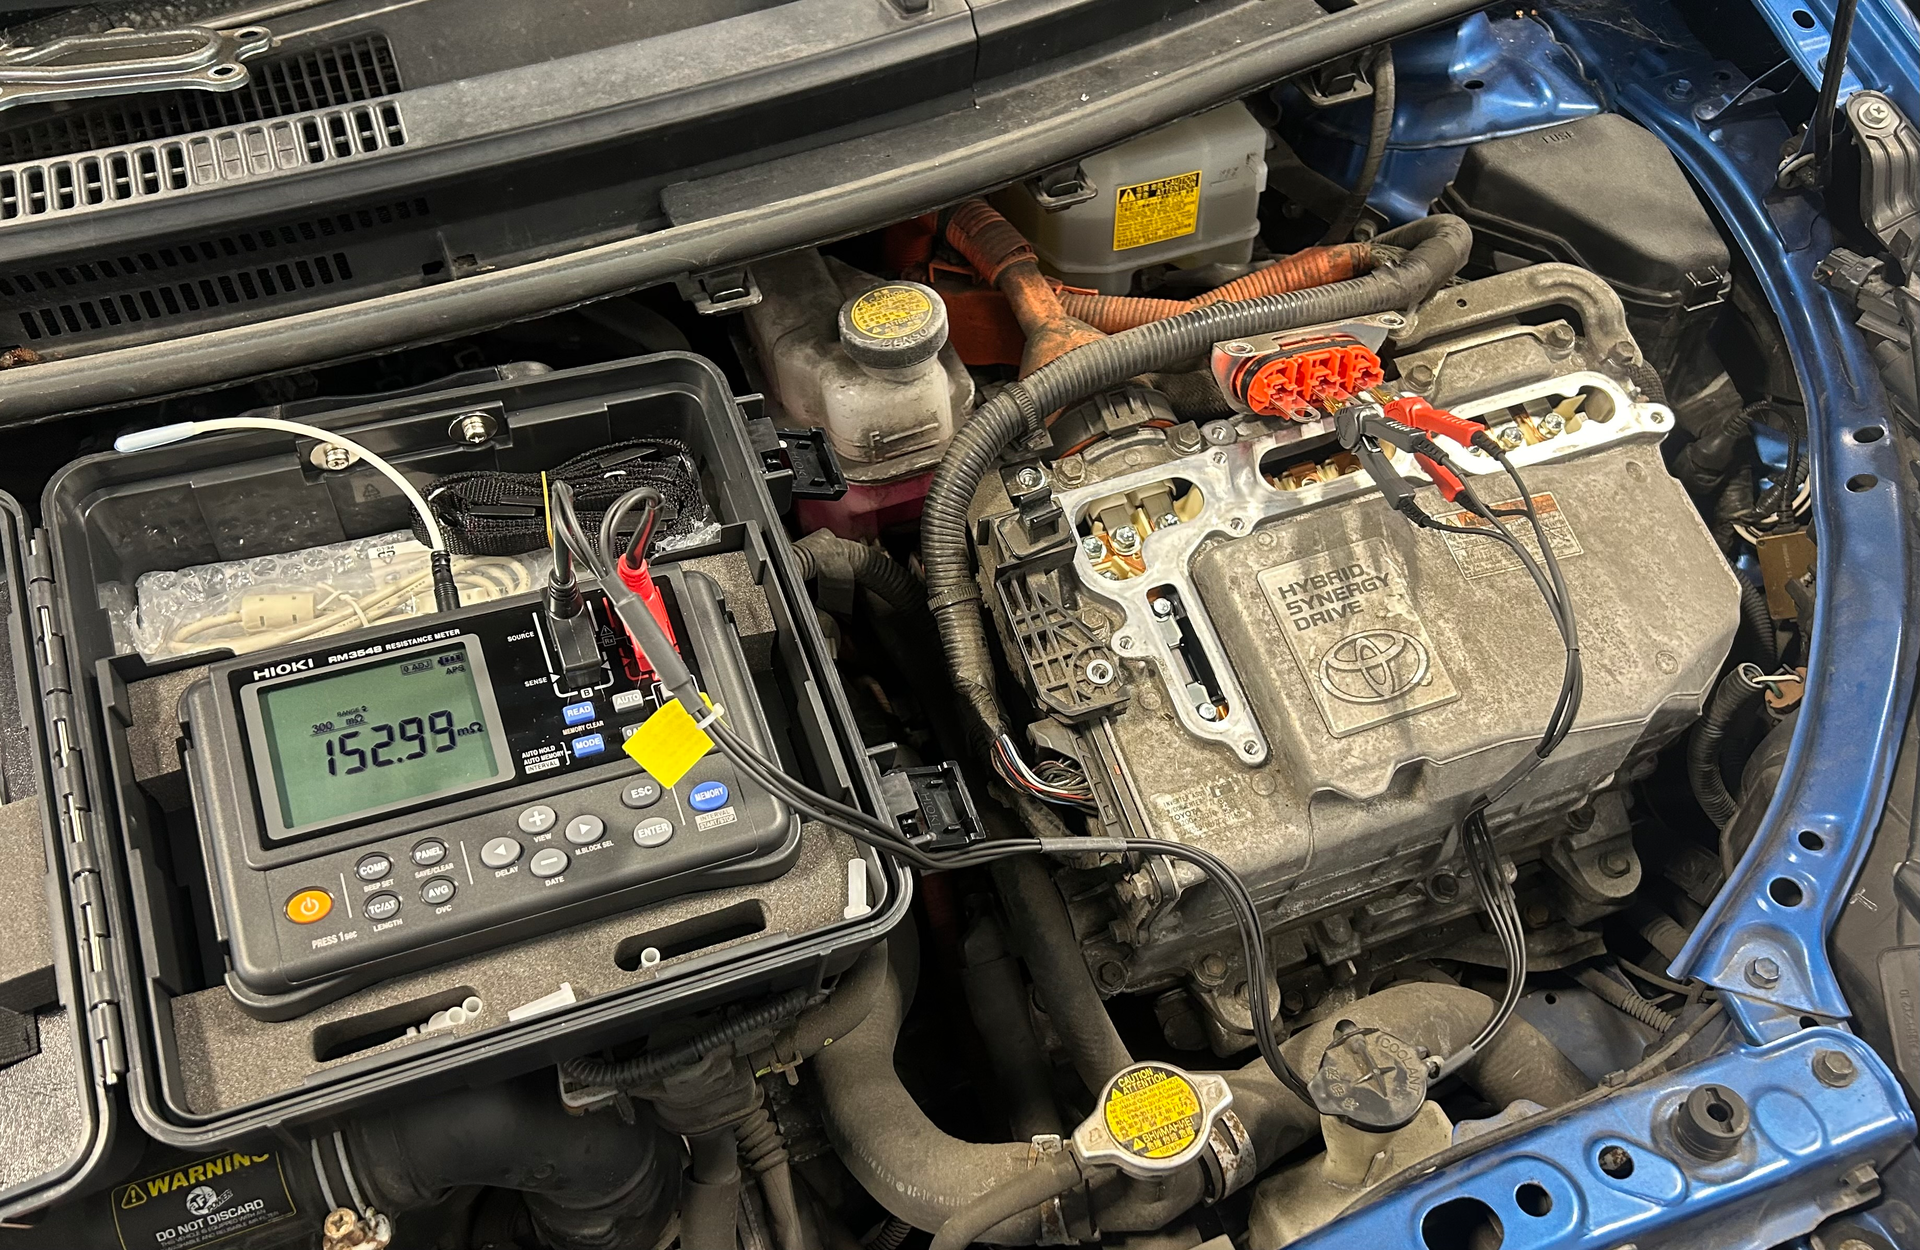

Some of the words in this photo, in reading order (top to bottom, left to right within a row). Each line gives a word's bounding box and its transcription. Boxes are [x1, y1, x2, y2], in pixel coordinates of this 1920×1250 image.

[881, 328, 928, 348] DENSO
[1278, 563, 1365, 600] HYBRID
[1285, 573, 1389, 616] SYNERGY
[1293, 600, 1364, 631] DRIVE
[507, 631, 535, 643] SOURCE
[253, 658, 314, 681] HIOKI
[328, 645, 383, 664] RM3548
[385, 634, 433, 651] RESISTANCE
[434, 628, 461, 640] METER
[411, 659, 430, 671] ADJ
[446, 664, 466, 676] APS
[524, 676, 548, 688] SENSE
[616, 693, 640, 706] AUTO
[566, 705, 592, 718] READ
[312, 720, 334, 735] 300
[562, 724, 585, 736] MEMORY
[585, 720, 605, 731] CLEAR
[326, 709, 457, 777] 152.99
[575, 738, 602, 750] MODE
[521, 748, 538, 759] AUTO
[538, 745, 556, 755] HOLD
[523, 755, 540, 765] AUTO
[540, 750, 564, 762] MEMORY
[527, 760, 558, 773] INTERVAL
[631, 785, 653, 799] ESC
[694, 787, 724, 802] MEMORY
[699, 808, 731, 822] INTERVAL
[1170, 807, 1201, 821] TOYOTA
[699, 815, 736, 830] START/STOP
[533, 832, 552, 843] VIEW
[638, 823, 669, 838] ENTER
[415, 846, 443, 860] PANEL
[575, 843, 602, 856] M.BLOCK
[602, 840, 614, 850] SEL
[360, 861, 388, 876] COMP
[414, 863, 455, 879] SAVE/CLEAR
[495, 865, 519, 878] DELAY
[363, 880, 381, 893] BEEP
[381, 878, 395, 888] SET
[544, 876, 565, 886] DATE
[428, 885, 449, 899] AVG
[435, 904, 453, 915] OVC
[373, 918, 404, 932] LENGTH
[311, 934, 338, 950] PRESS
[1380, 1037, 1421, 1096] COOLANT
[1118, 1067, 1154, 1088] CAUTION
[1123, 1071, 1168, 1096] ATTENTION
[1166, 1078, 1179, 1087] HOT
[155, 1228, 176, 1243] DO
[177, 1219, 204, 1236] NOT
[207, 1199, 265, 1226] DISCARD
